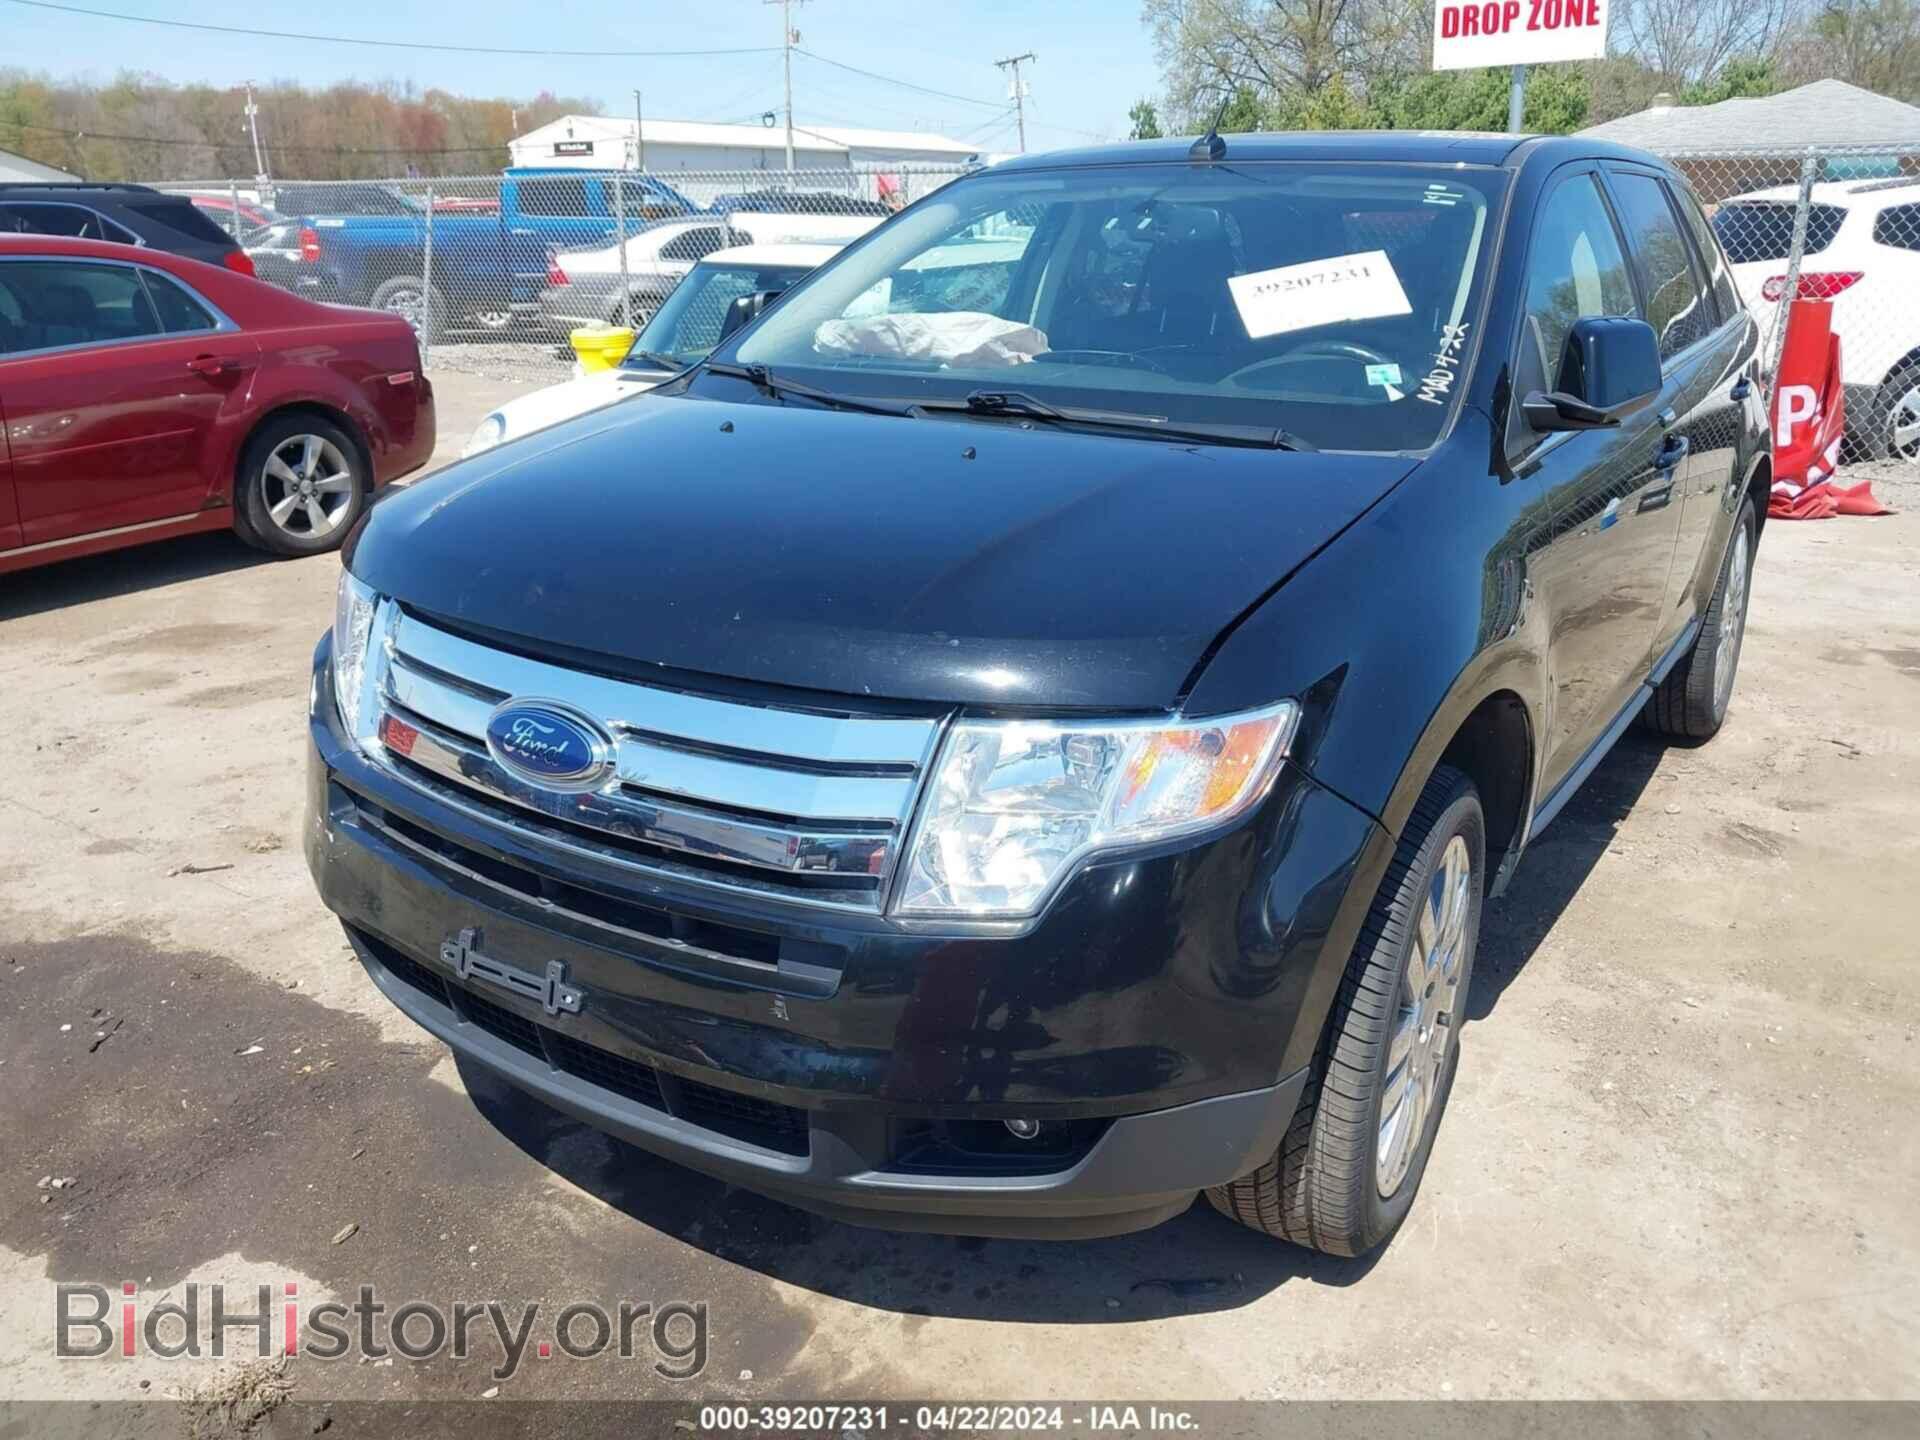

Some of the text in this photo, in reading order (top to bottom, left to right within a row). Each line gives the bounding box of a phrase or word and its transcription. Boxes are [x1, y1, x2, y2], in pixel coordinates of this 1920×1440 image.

[1441, 0, 1600, 38] DROP ZONE
[1252, 265, 1373, 298] 39207231
[504, 717, 569, 766] Ford
